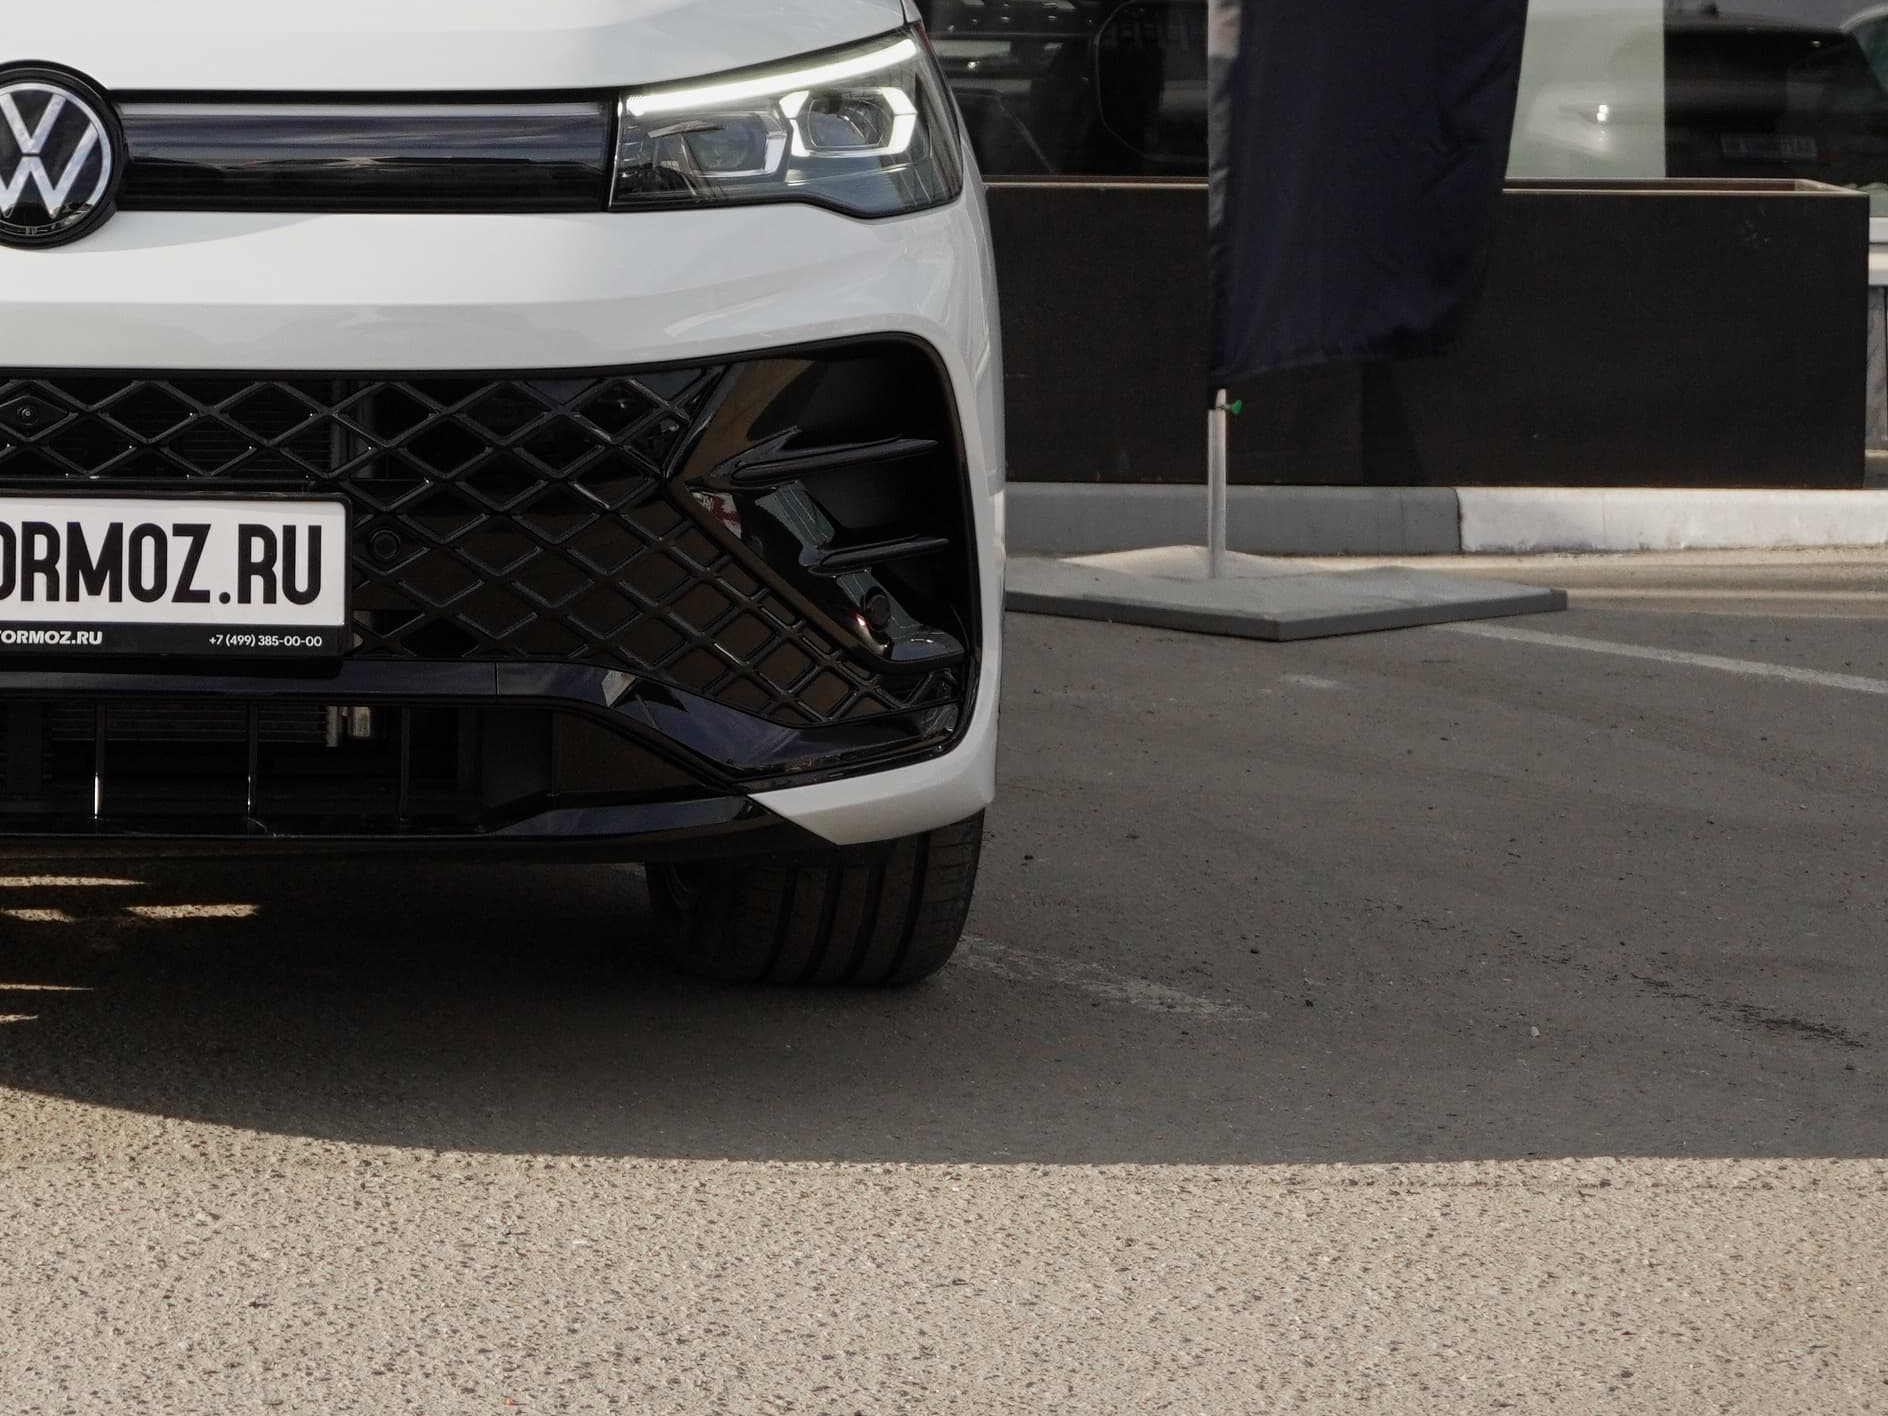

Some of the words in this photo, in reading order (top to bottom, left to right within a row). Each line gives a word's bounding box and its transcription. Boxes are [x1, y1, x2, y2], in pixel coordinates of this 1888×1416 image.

[209, 635, 224, 646] +7
[225, 634, 256, 647] (499)
[257, 635, 323, 647] 385-00-00
